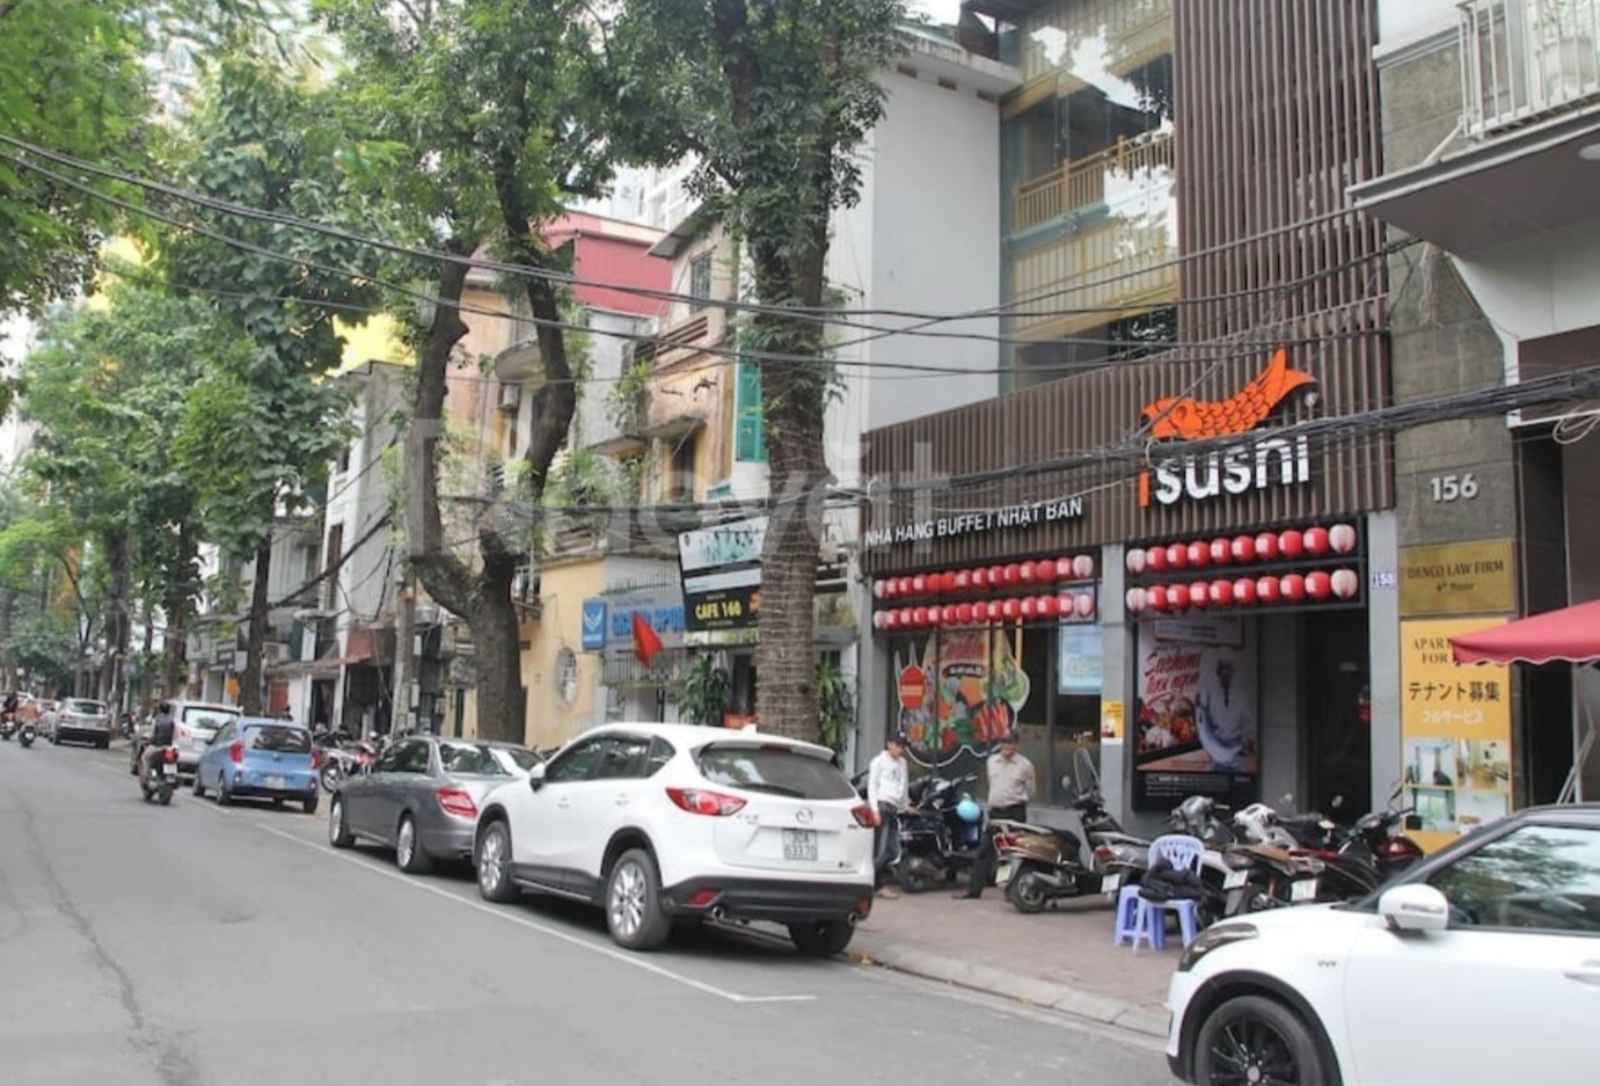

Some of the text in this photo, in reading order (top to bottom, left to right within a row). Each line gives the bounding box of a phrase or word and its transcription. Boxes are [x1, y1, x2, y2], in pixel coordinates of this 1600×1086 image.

[1431, 472, 1478, 501] 156
[1447, 562, 1473, 577] LAW
[1475, 559, 1504, 576] FIRM
[1422, 651, 1448, 664] FOR
[1408, 680, 1500, 702] テナント募集
